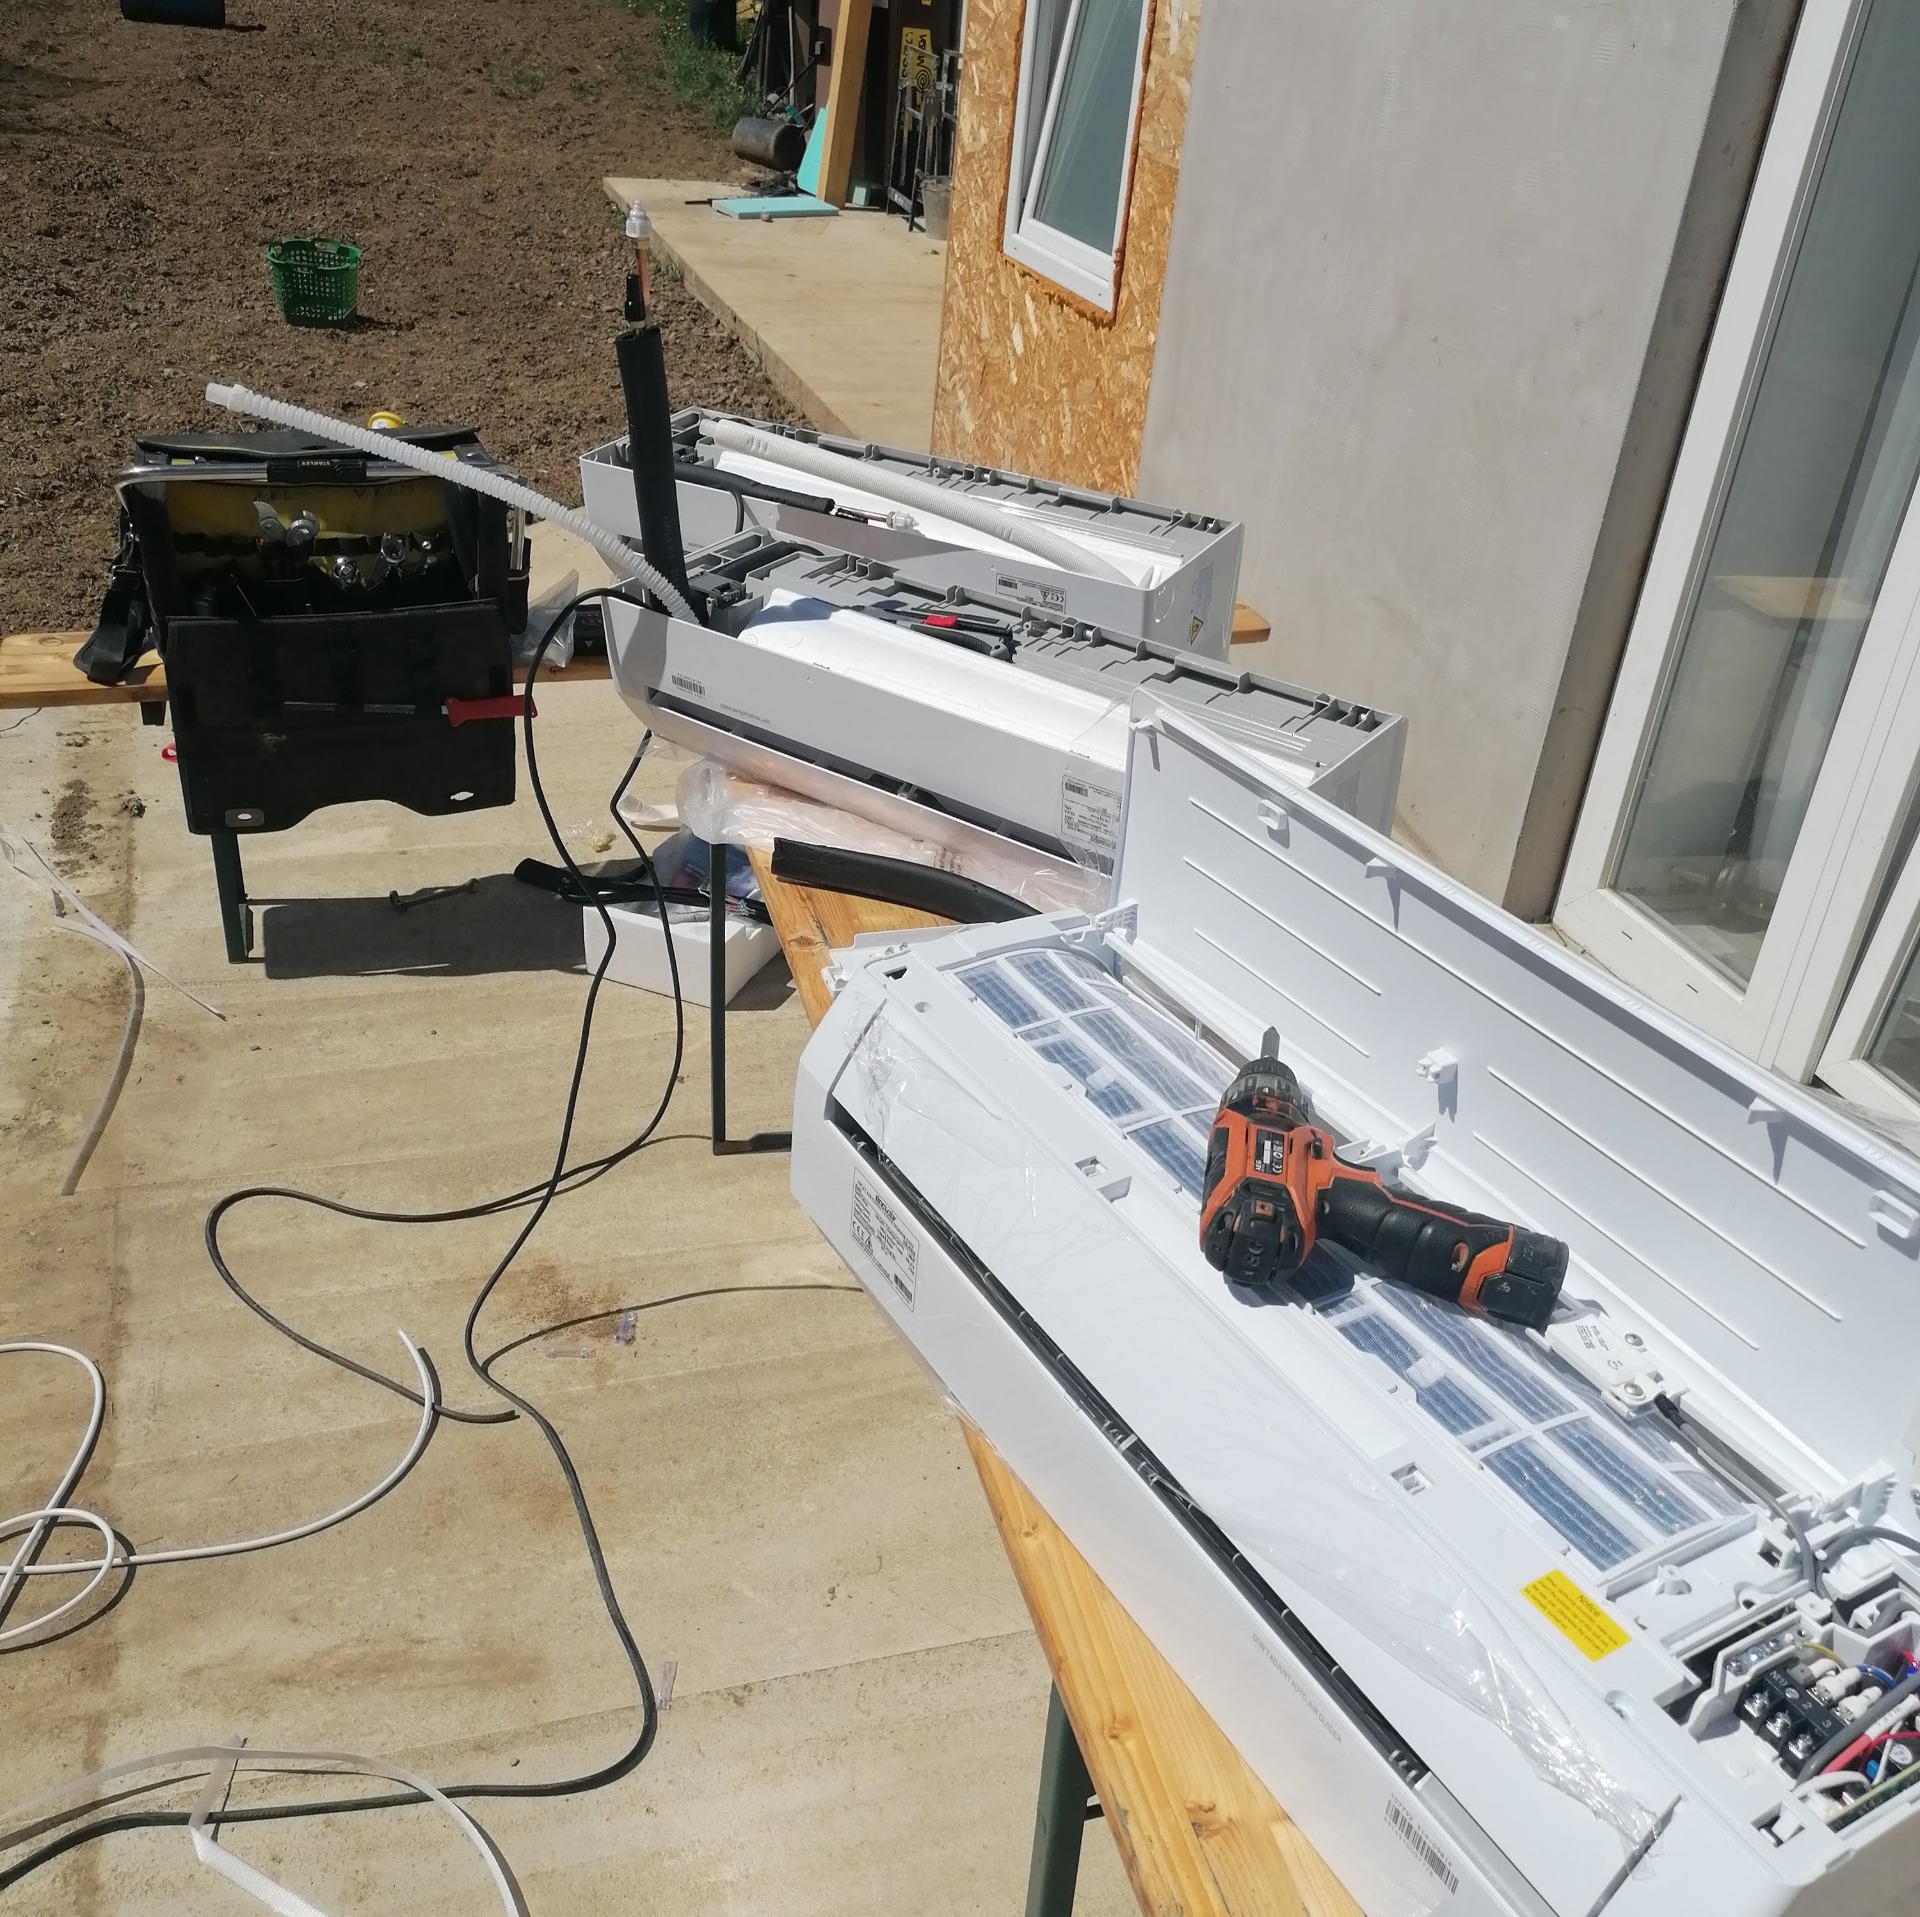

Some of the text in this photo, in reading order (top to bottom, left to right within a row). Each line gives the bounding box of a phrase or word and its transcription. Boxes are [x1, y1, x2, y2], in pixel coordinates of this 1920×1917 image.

[1575, 1594, 1601, 1617] Notice
[1252, 1632, 1342, 1744] DON'T ADJUST AUTO-AIR GUIDER
[1802, 1702, 1812, 1710] 2
[1822, 1720, 1832, 1728] 3
